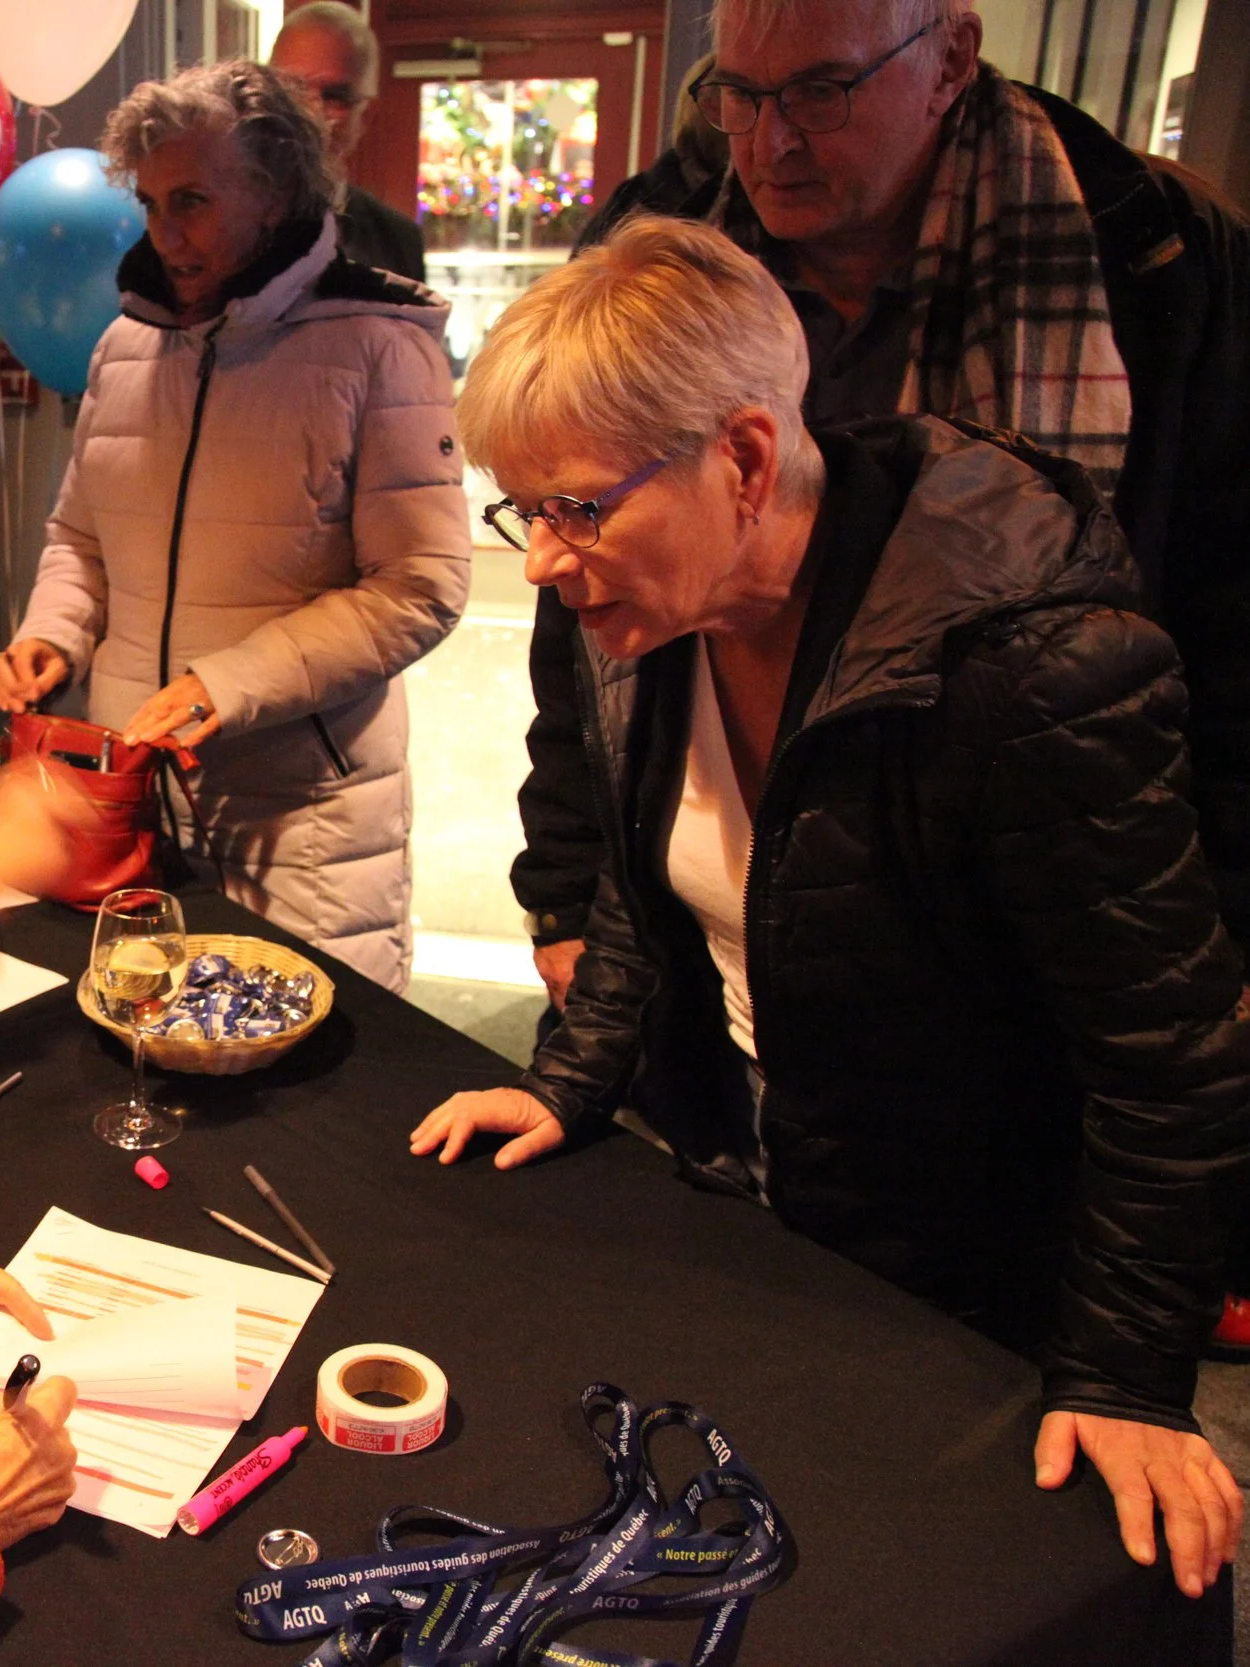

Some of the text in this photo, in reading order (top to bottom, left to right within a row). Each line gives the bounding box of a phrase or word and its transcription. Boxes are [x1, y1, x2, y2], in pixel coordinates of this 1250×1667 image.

[346, 1431, 383, 1442] ALCOOL
[346, 1439, 383, 1450] LIQUOR
[707, 1428, 732, 1467] AGTQ
[211, 1479, 234, 1499] ACCENT
[612, 1538, 626, 1554] de
[620, 1508, 649, 1541] Québec
[489, 1539, 541, 1560] Association
[665, 1549, 697, 1561] Notre
[698, 1548, 726, 1563] passé
[433, 1553, 469, 1569] guides
[471, 1552, 488, 1564] des
[349, 1571, 362, 1583] de
[364, 1560, 430, 1580] touristiques
[306, 1576, 347, 1591] Québec
[722, 1582, 738, 1593] des
[740, 1569, 768, 1589] guides
[593, 1596, 640, 1610] AGTQ
[283, 1604, 327, 1631] AGTQ
[499, 1613, 511, 1628] de
